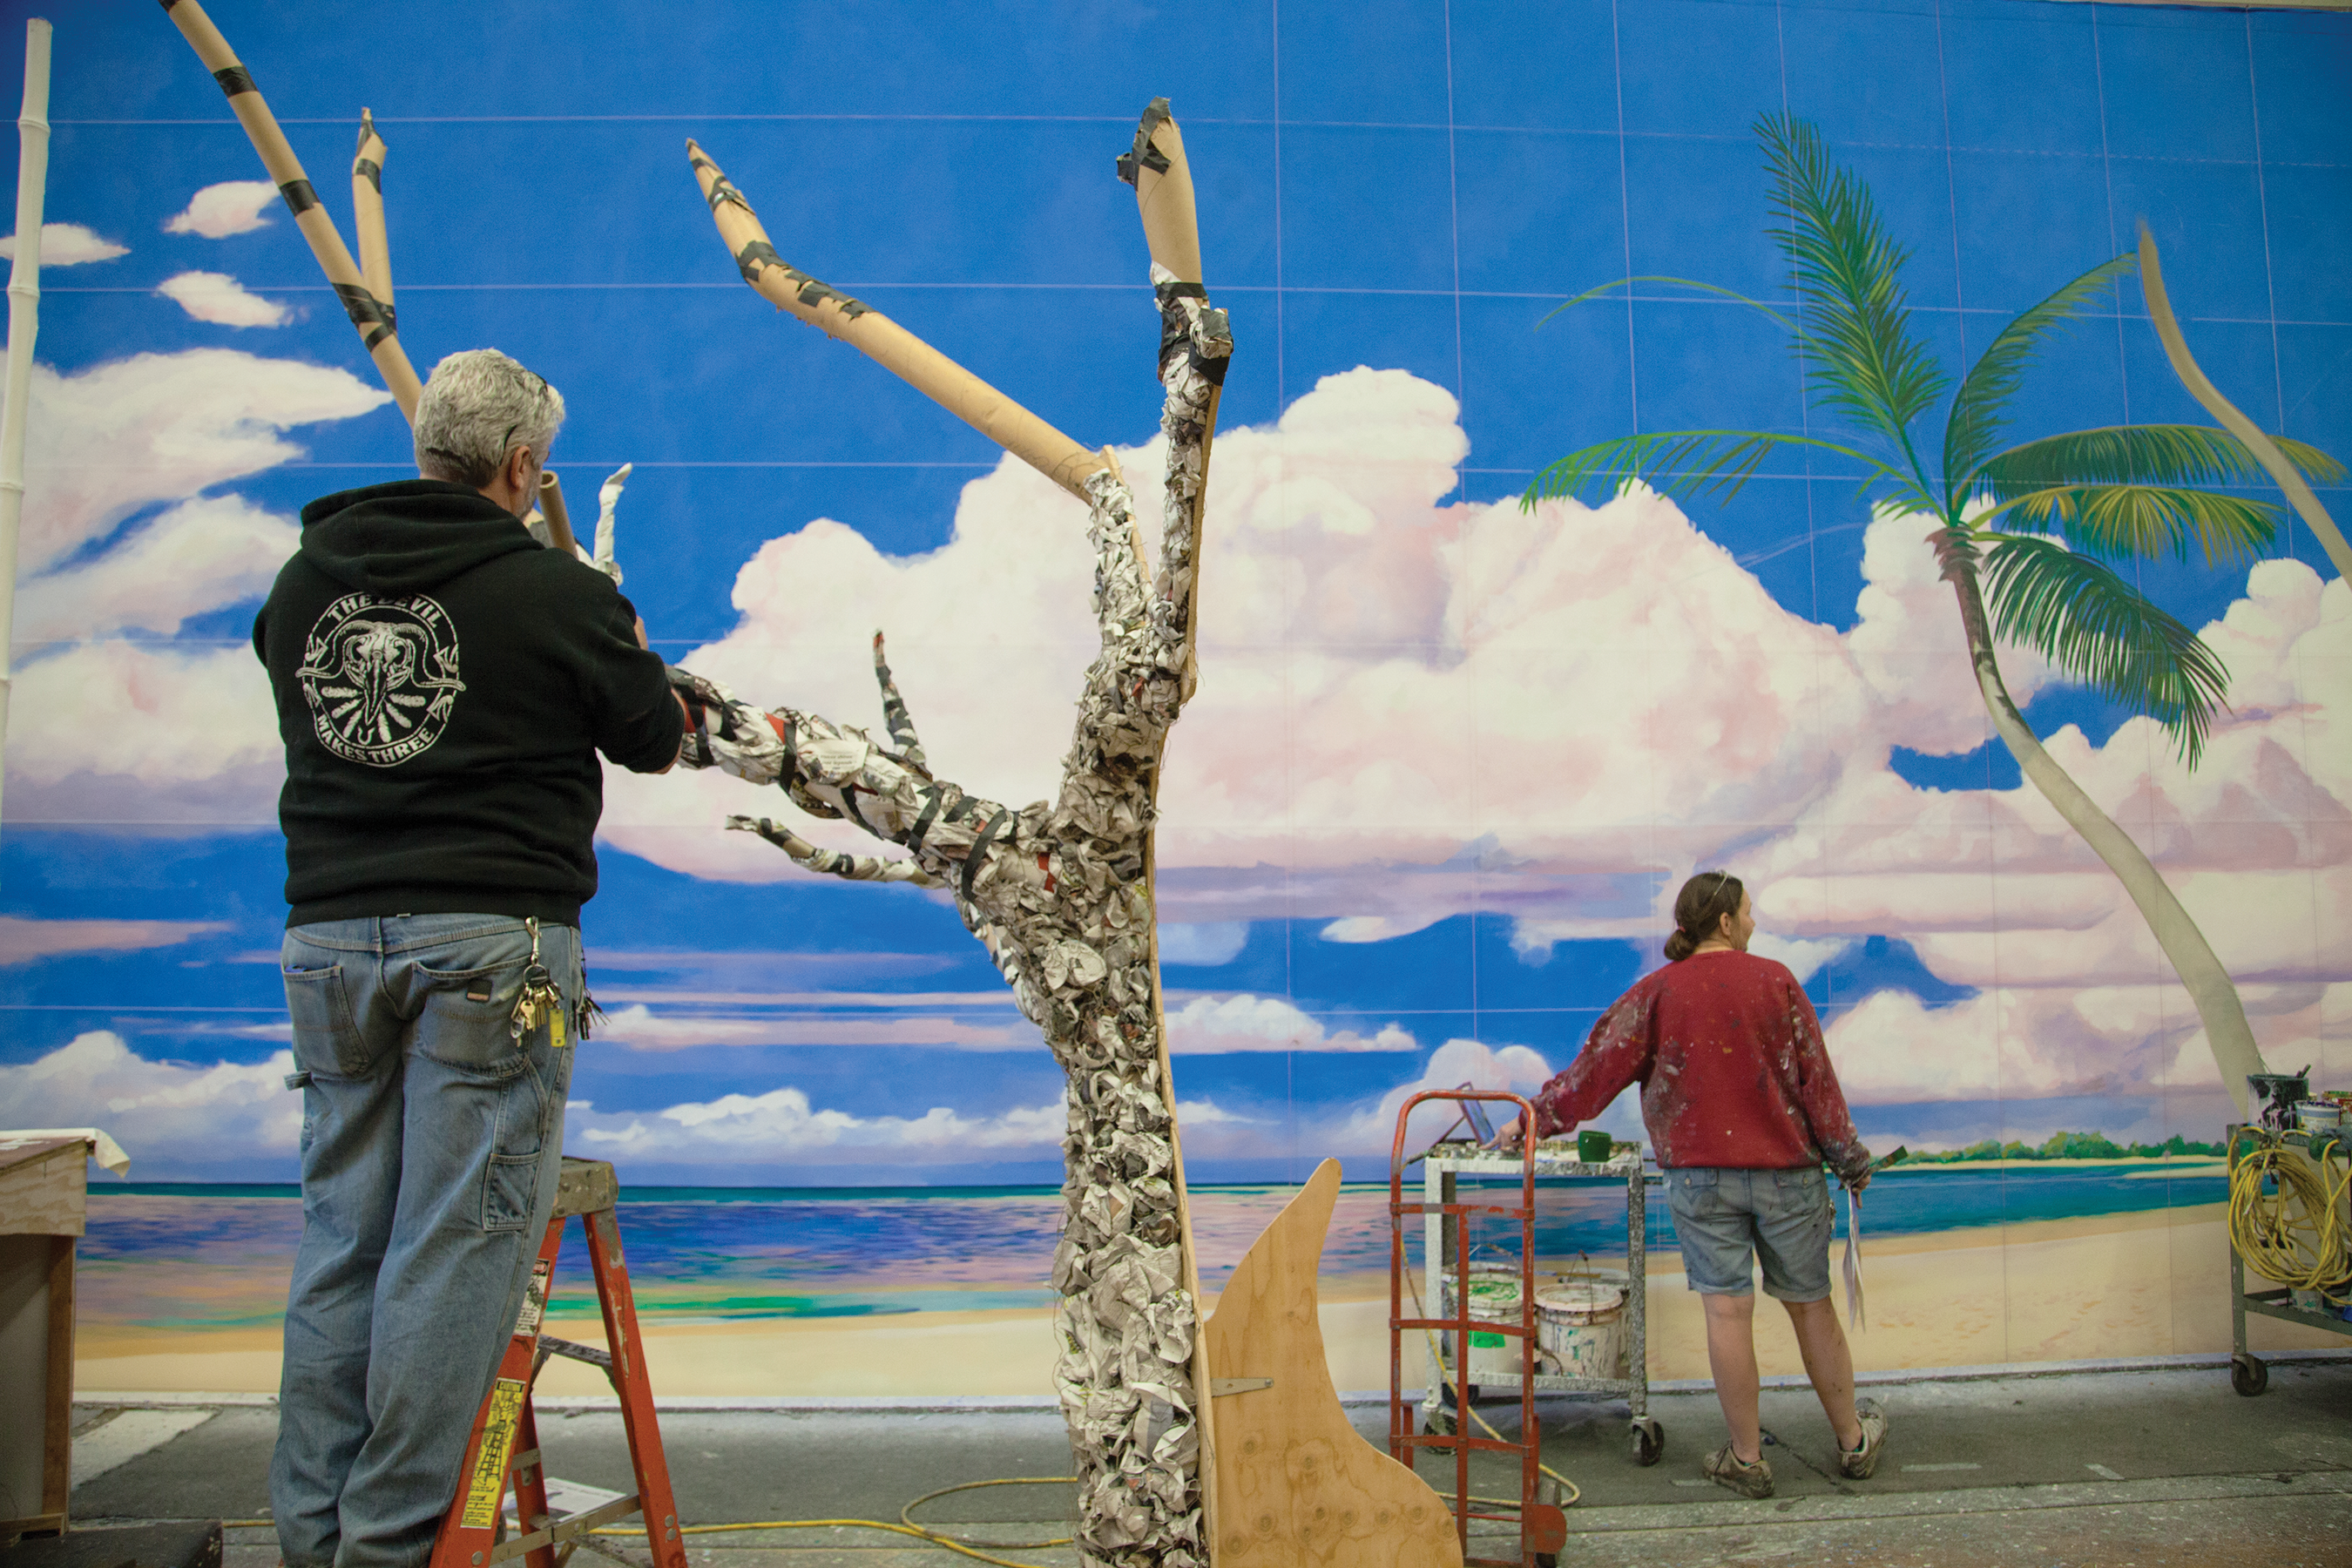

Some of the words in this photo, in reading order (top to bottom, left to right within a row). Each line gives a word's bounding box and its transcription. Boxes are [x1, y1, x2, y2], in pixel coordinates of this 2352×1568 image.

[327, 594, 372, 622] THE
[317, 713, 367, 760] MAKES
[368, 727, 435, 763] THREE
